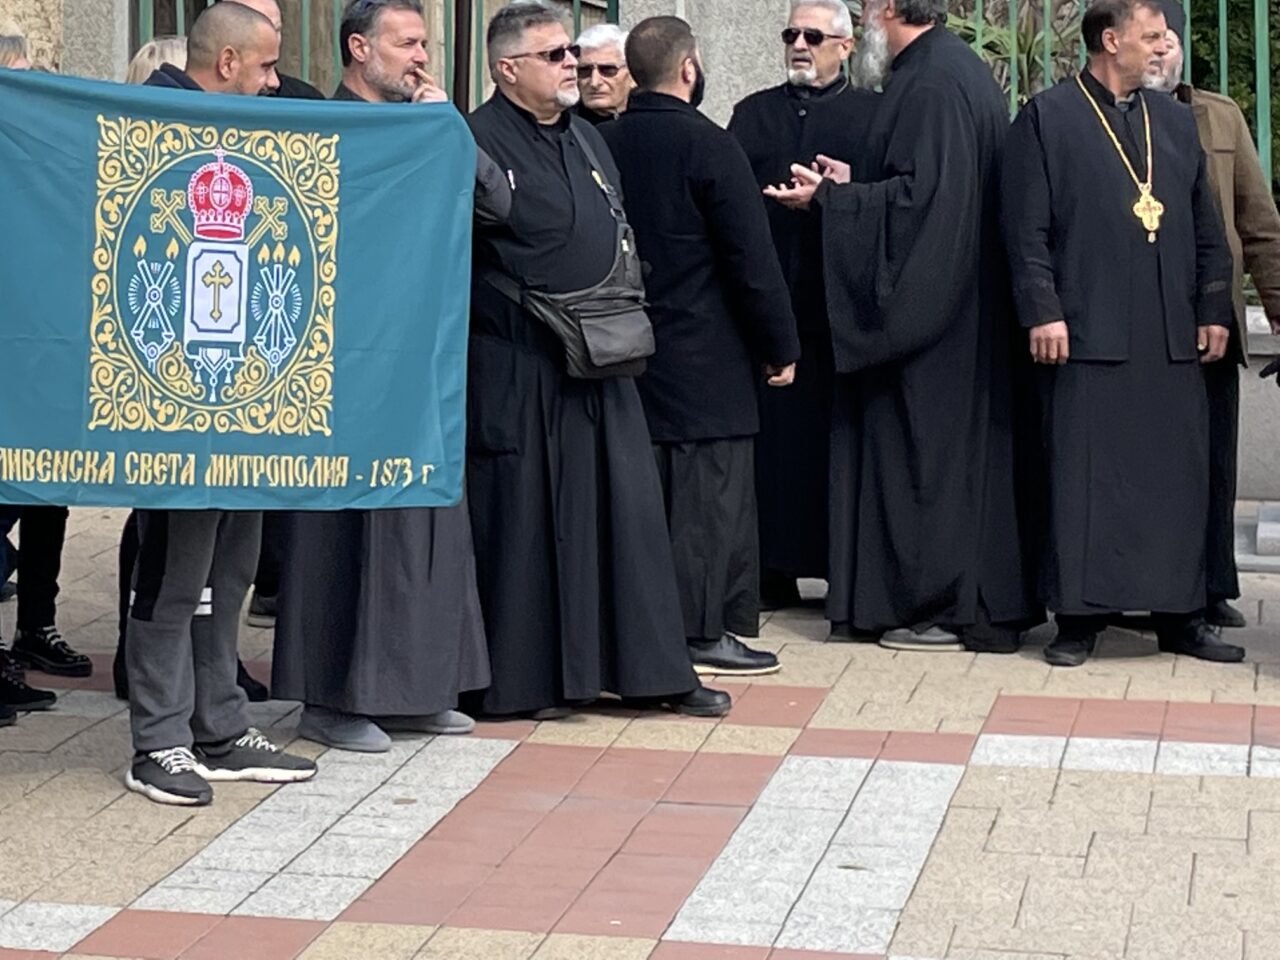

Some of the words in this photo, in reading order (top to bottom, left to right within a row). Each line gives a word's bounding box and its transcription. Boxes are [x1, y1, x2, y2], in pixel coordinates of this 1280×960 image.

[123, 451, 197, 487] СВЕТА
[204, 454, 350, 488] МИТРОПОЛИЯ
[369, 457, 415, 488] 1873
